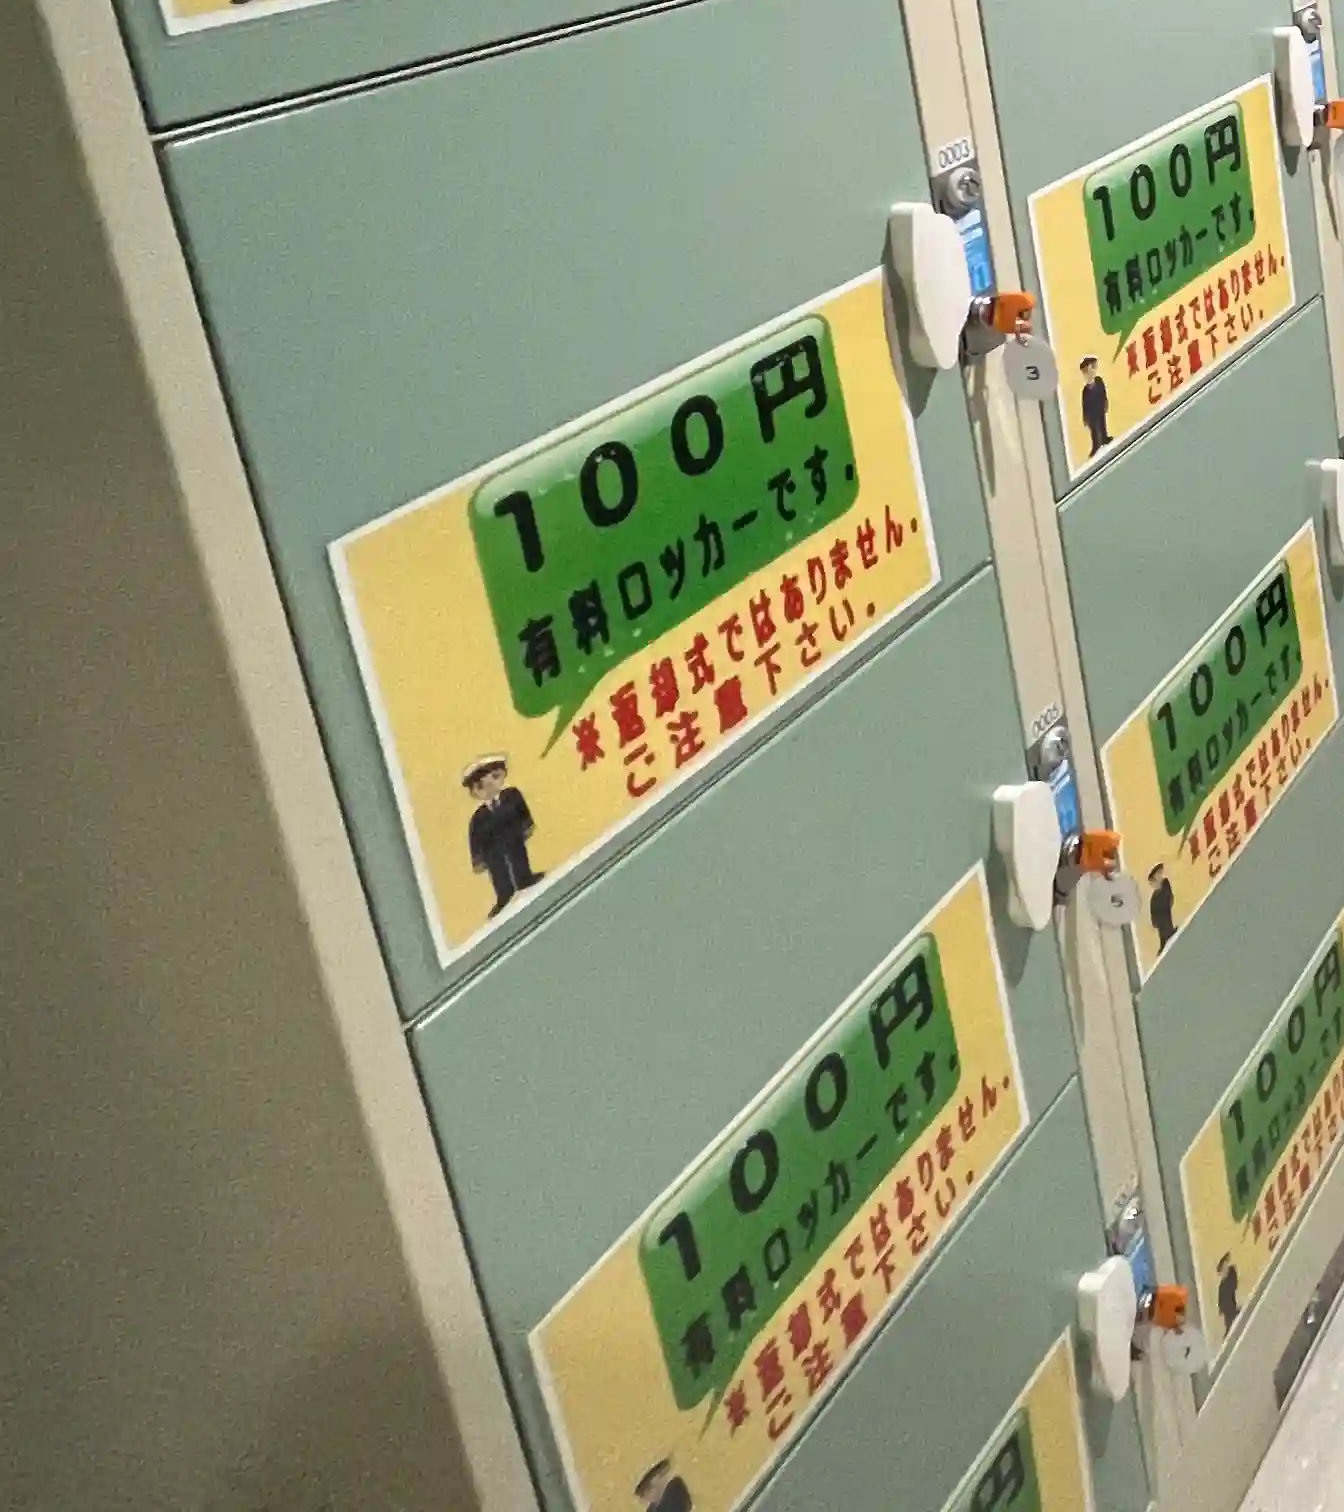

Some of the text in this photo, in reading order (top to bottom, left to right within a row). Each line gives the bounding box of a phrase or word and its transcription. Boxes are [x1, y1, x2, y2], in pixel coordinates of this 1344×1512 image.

[1092, 113, 1242, 242] 100円
[492, 334, 828, 574] 100円
[1025, 366, 1041, 381] 3
[1156, 571, 1290, 752] 100円
[1110, 894, 1125, 908] 5
[658, 952, 935, 1282] 100円
[1226, 940, 1341, 1143] 100円
[724, 1073, 1011, 1434] 式ではありません。
